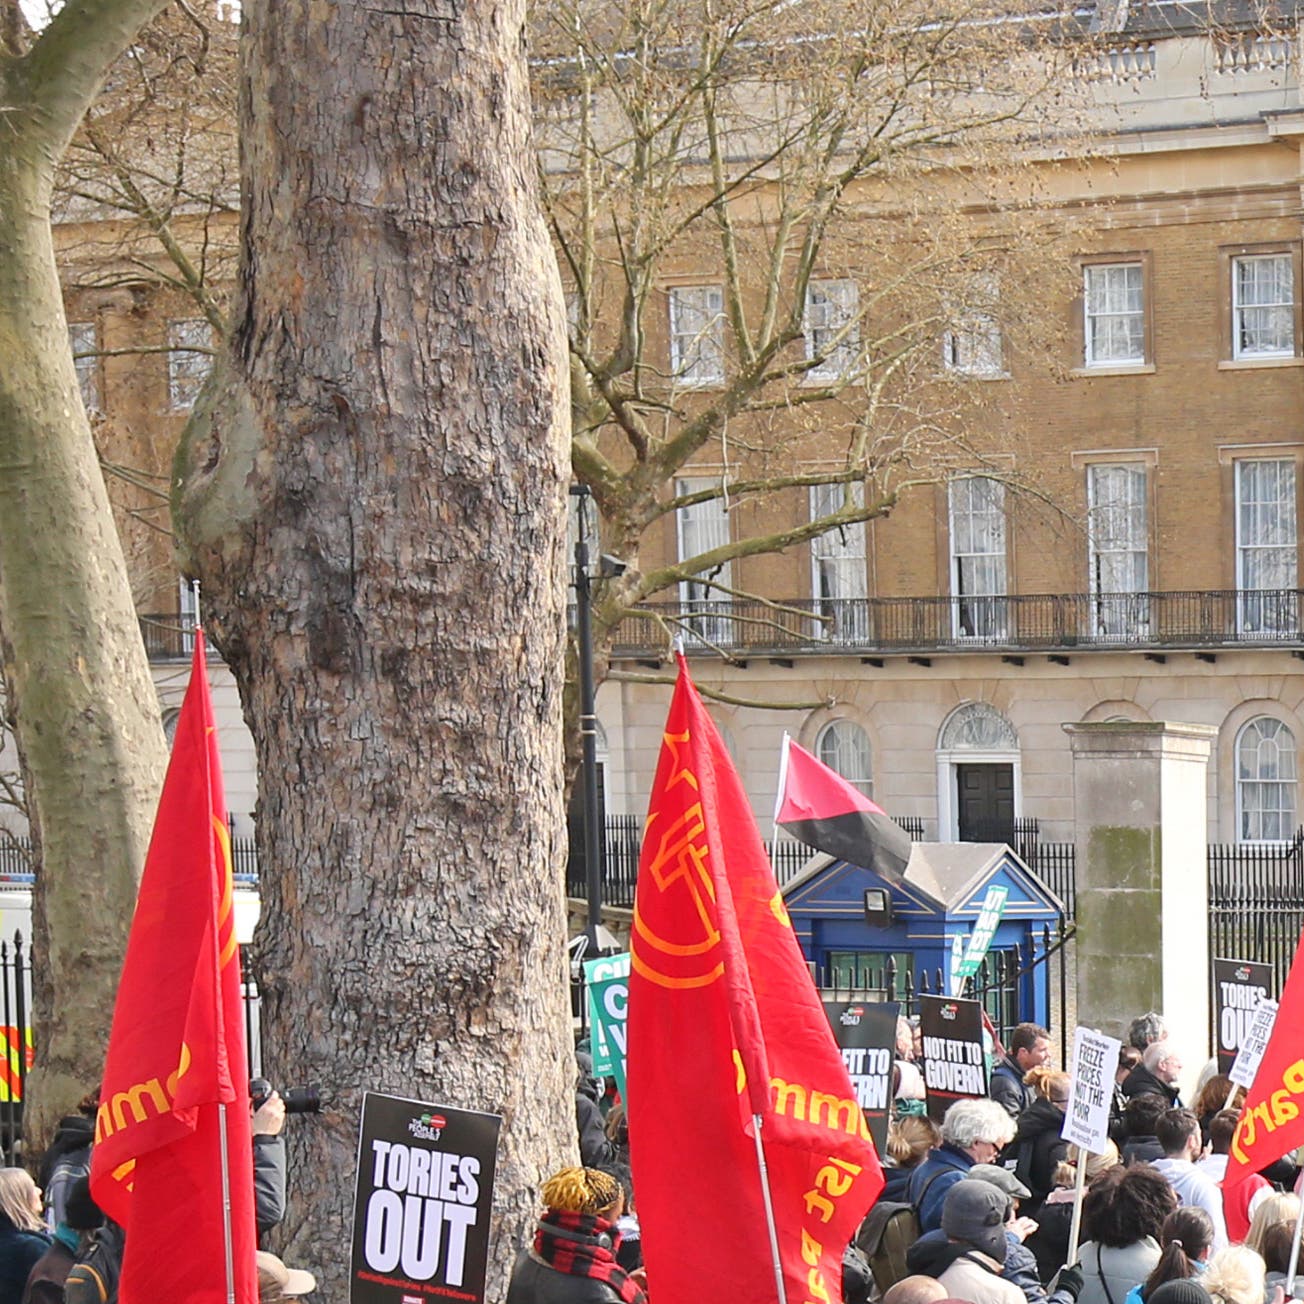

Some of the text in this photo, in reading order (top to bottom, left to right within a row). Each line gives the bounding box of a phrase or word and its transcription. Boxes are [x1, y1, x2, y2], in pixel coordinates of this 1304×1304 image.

[1220, 982, 1267, 1008] TORIES
[868, 1049, 891, 1075] TO
[923, 1035, 983, 1065] NOT FIT TO
[1079, 1044, 1105, 1069] FREEZE
[924, 1061, 986, 1095] GOVERN
[1088, 1086, 1104, 1107] THE
[372, 1139, 480, 1205] TORIES
[365, 1189, 477, 1287] OUT
